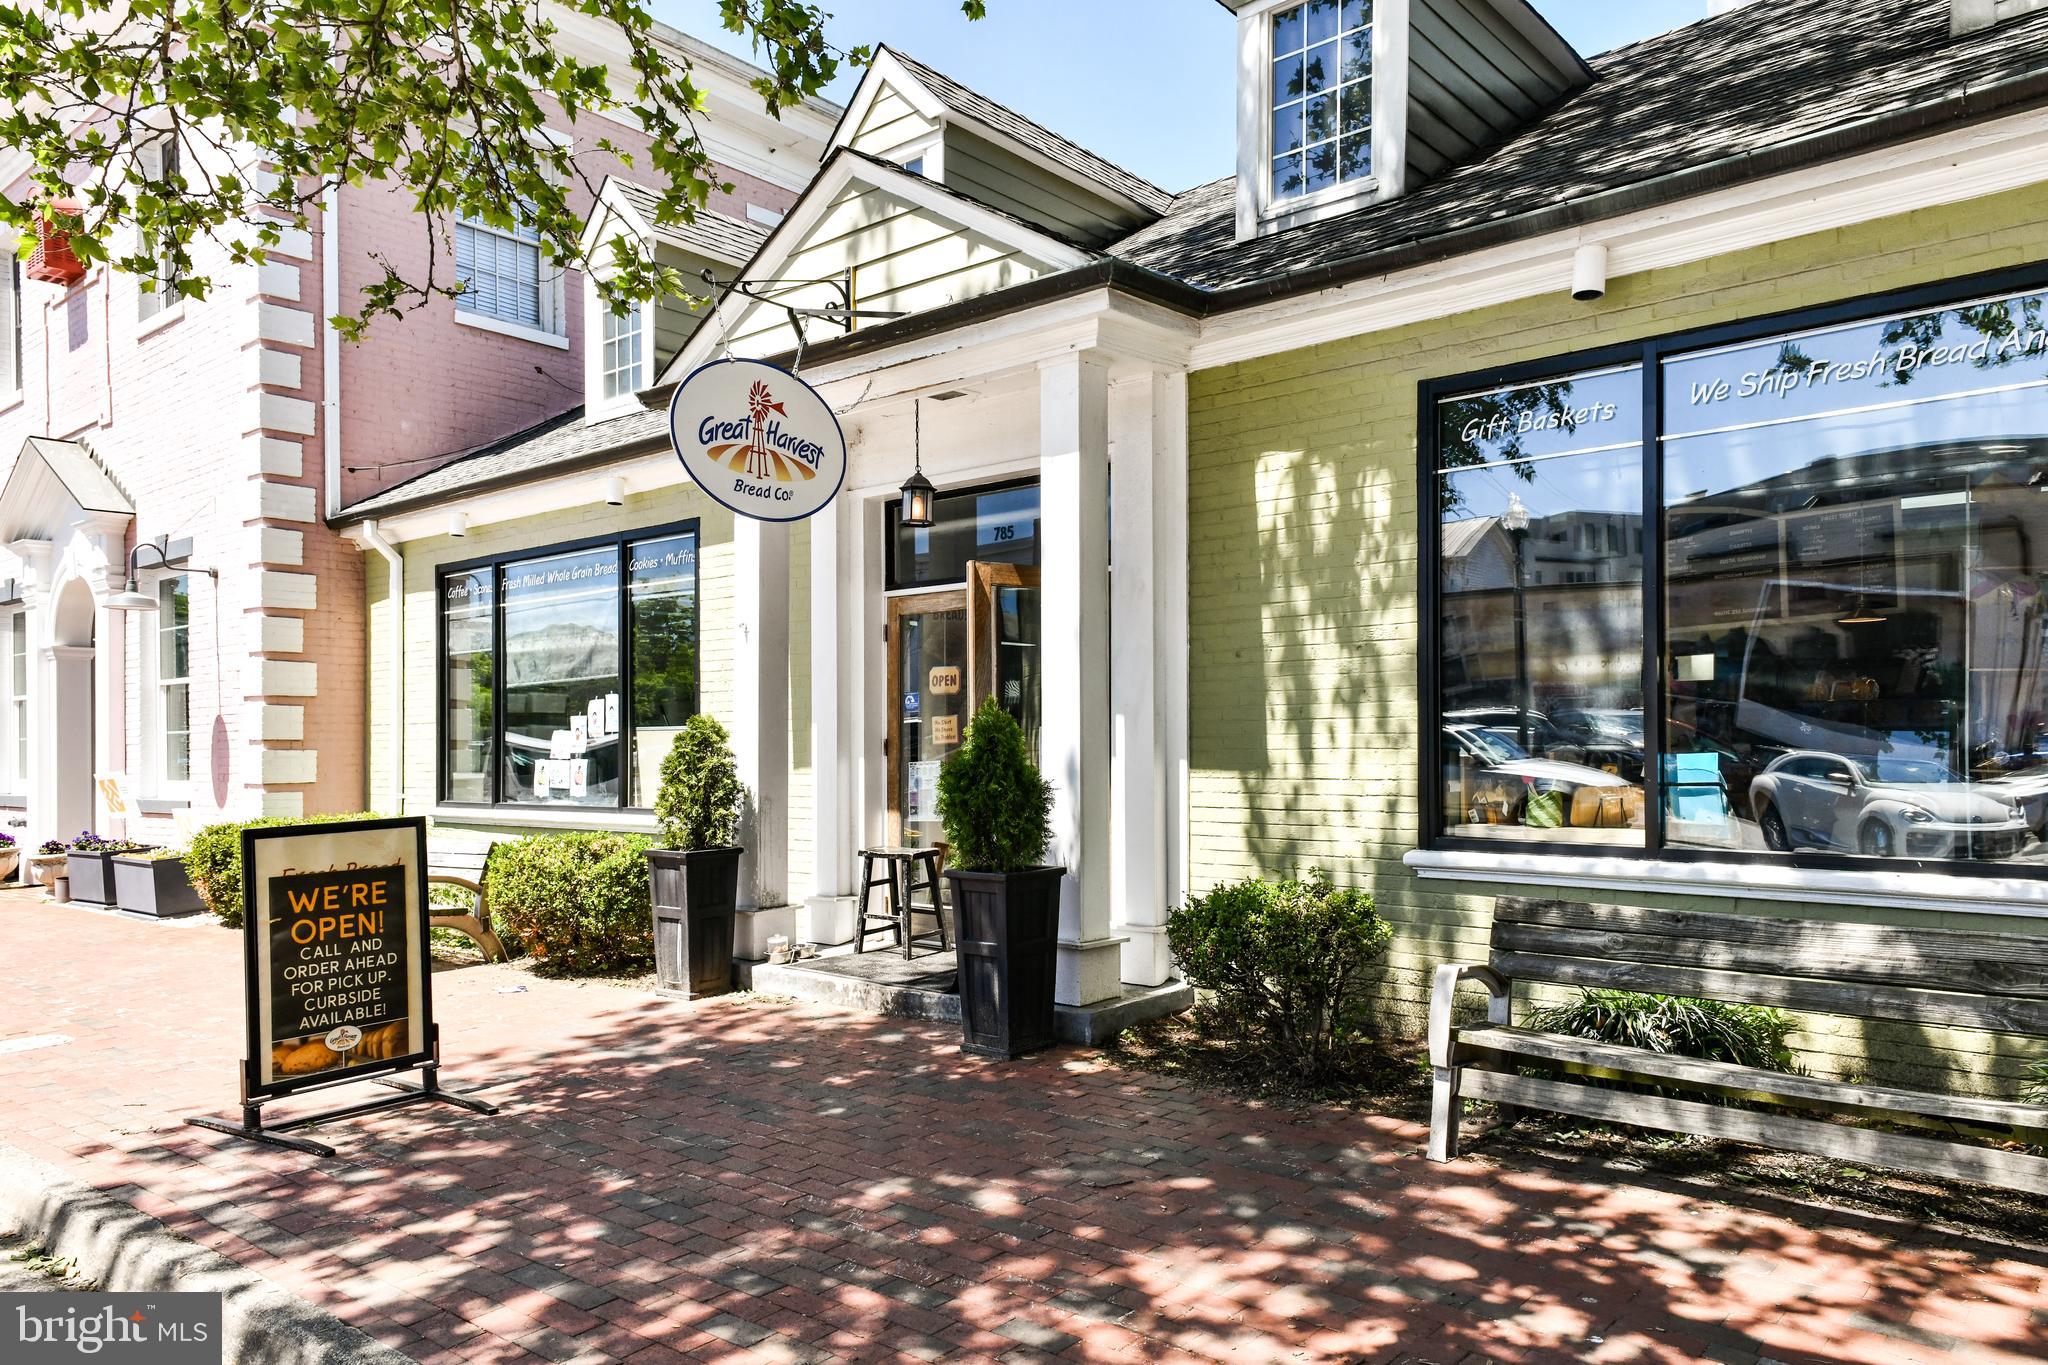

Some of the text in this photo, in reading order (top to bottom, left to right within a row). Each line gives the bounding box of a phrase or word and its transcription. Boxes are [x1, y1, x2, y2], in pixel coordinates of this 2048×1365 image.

[1690, 377, 1731, 405] We
[1737, 366, 1799, 399] Ship
[1806, 348, 1887, 388] Fresh
[1895, 329, 1993, 372] Bread
[1461, 400, 1618, 442] Gift Baskets
[698, 415, 826, 470] Great Harvest
[733, 478, 771, 500] Bread
[993, 525, 1015, 542] 785
[501, 577, 521, 591] Fresh
[522, 575, 545, 588] Milled
[547, 568, 570, 583] Whole
[571, 564, 593, 580] Grain
[628, 556, 659, 572] Cookies
[447, 584, 469, 600] Coffee
[931, 673, 957, 688] OPEN
[287, 880, 388, 914] WE'RE
[290, 911, 384, 945] OPEN!
[299, 937, 383, 961] CALL AND
[283, 952, 398, 981] ORDER AHEAD
[291, 969, 392, 997] FOR PICK UP.
[304, 986, 382, 1012] CURBSIDE
[299, 1003, 387, 1030] AVAILABLE!
